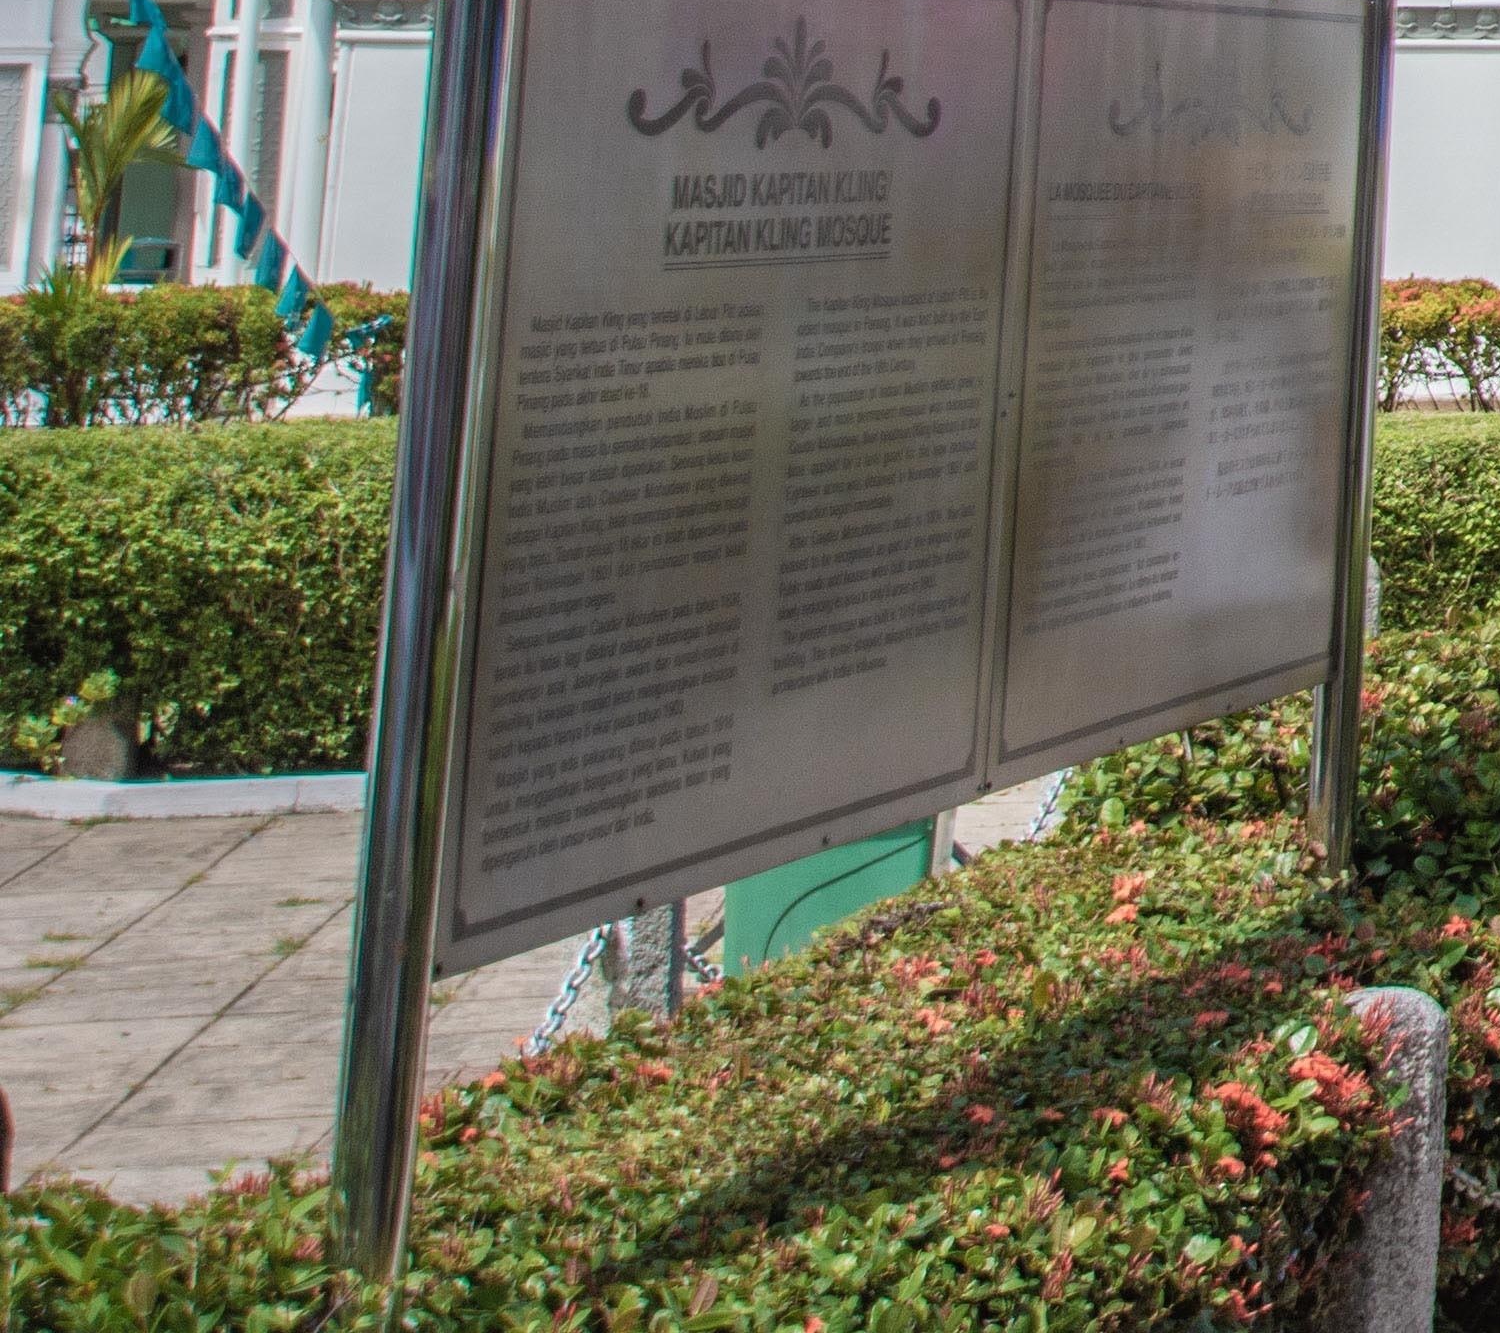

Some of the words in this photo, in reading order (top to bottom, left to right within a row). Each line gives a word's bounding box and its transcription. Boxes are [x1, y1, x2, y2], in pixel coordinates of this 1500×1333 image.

[672, 173, 747, 209] MASJID
[751, 172, 830, 207] KAPITAN
[834, 171, 892, 204] KLING/
[665, 218, 751, 256] KAPITAN
[755, 216, 812, 251] KLING
[816, 213, 893, 248] MOSQUE
